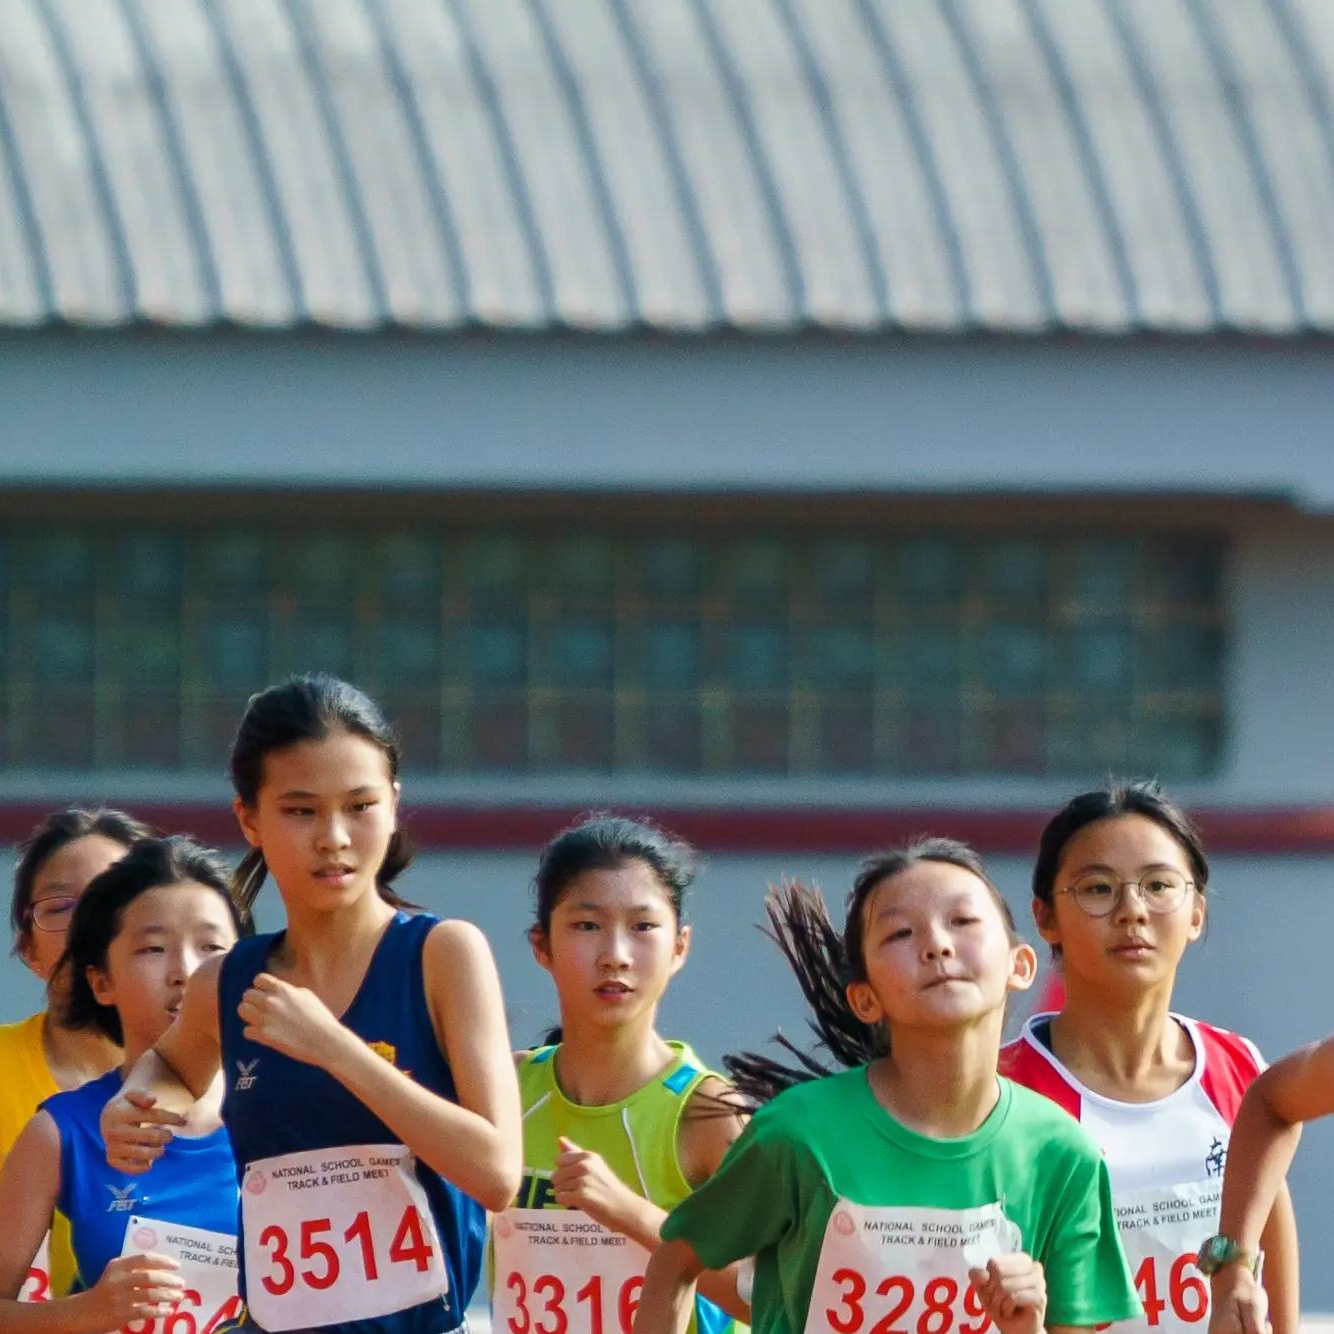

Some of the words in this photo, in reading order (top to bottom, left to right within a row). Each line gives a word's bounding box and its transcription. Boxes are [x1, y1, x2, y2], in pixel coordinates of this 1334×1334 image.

[271, 1164, 316, 1179] NATIONAL
[320, 1157, 365, 1172] SCHOOL
[287, 1177, 320, 1191] TRACK
[322, 1176, 329, 1186] &
[330, 1171, 360, 1184] FIELD
[362, 1168, 390, 1180] MEET
[1152, 1198, 1196, 1212] SCHOOL
[1198, 1193, 1220, 1205] GAM
[562, 1223, 604, 1233] SCHOOL
[863, 1220, 915, 1232] NATIONAL
[922, 1222, 965, 1234] SCHOOL
[1117, 1216, 1151, 1231] TRACK
[1153, 1217, 1160, 1226] &
[1161, 1211, 1190, 1225] FIELD
[1192, 1206, 1217, 1219] MEET
[165, 1235, 212, 1252] NATIONAL
[218, 1245, 238, 1255] SCH
[258, 1205, 434, 1296] 3514
[528, 1235, 560, 1245] TRACK
[562, 1235, 569, 1245] &
[570, 1235, 598, 1246] FIELD
[600, 1237, 626, 1247] MEET
[881, 1234, 915, 1246] TRACK
[917, 1235, 924, 1246] &
[927, 1236, 958, 1248] FIELD
[179, 1250, 212, 1264] TRACK
[212, 1258, 220, 1266] &
[1096, 1252, 1209, 1332] 46
